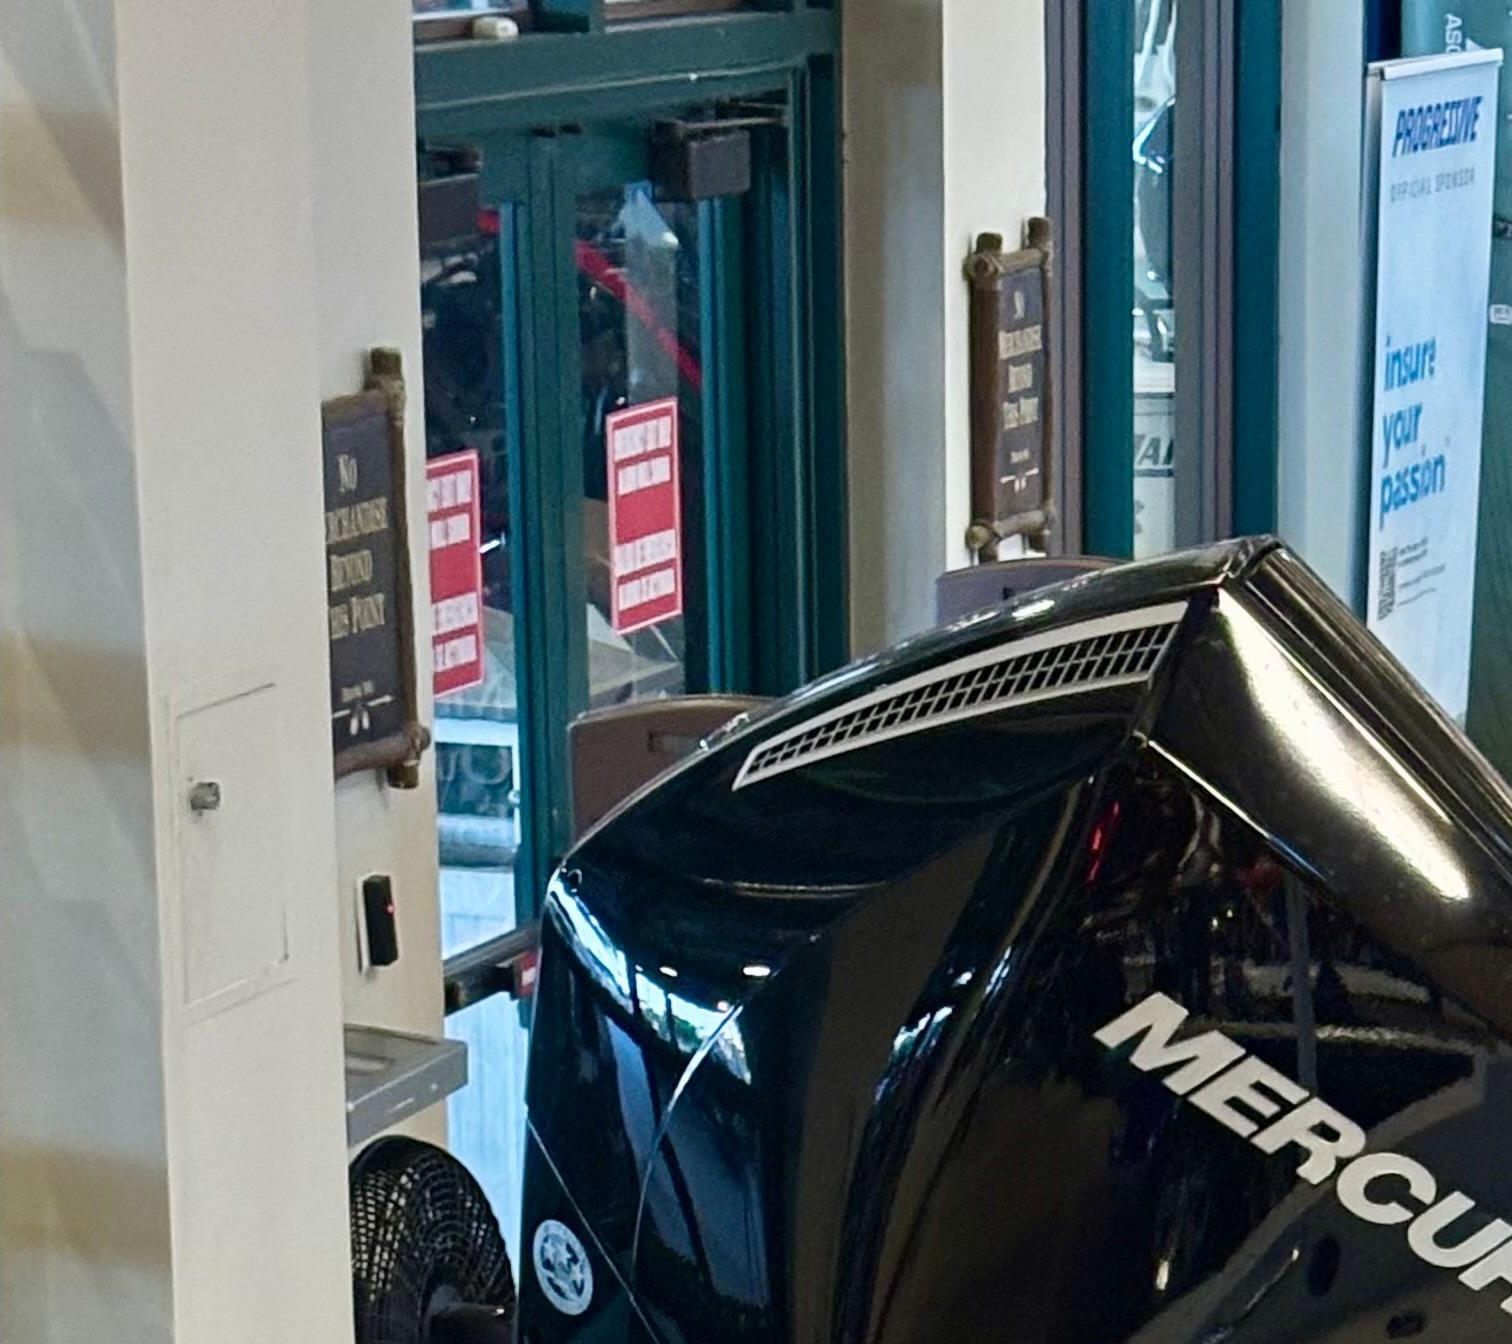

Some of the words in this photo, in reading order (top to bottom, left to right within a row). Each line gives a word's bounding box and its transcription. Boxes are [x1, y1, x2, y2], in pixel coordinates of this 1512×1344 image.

[1392, 96, 1483, 158] PROGRESSIVE
[1384, 336, 1436, 391] insure
[1382, 403, 1423, 469] your
[1379, 446, 1446, 531] passion
